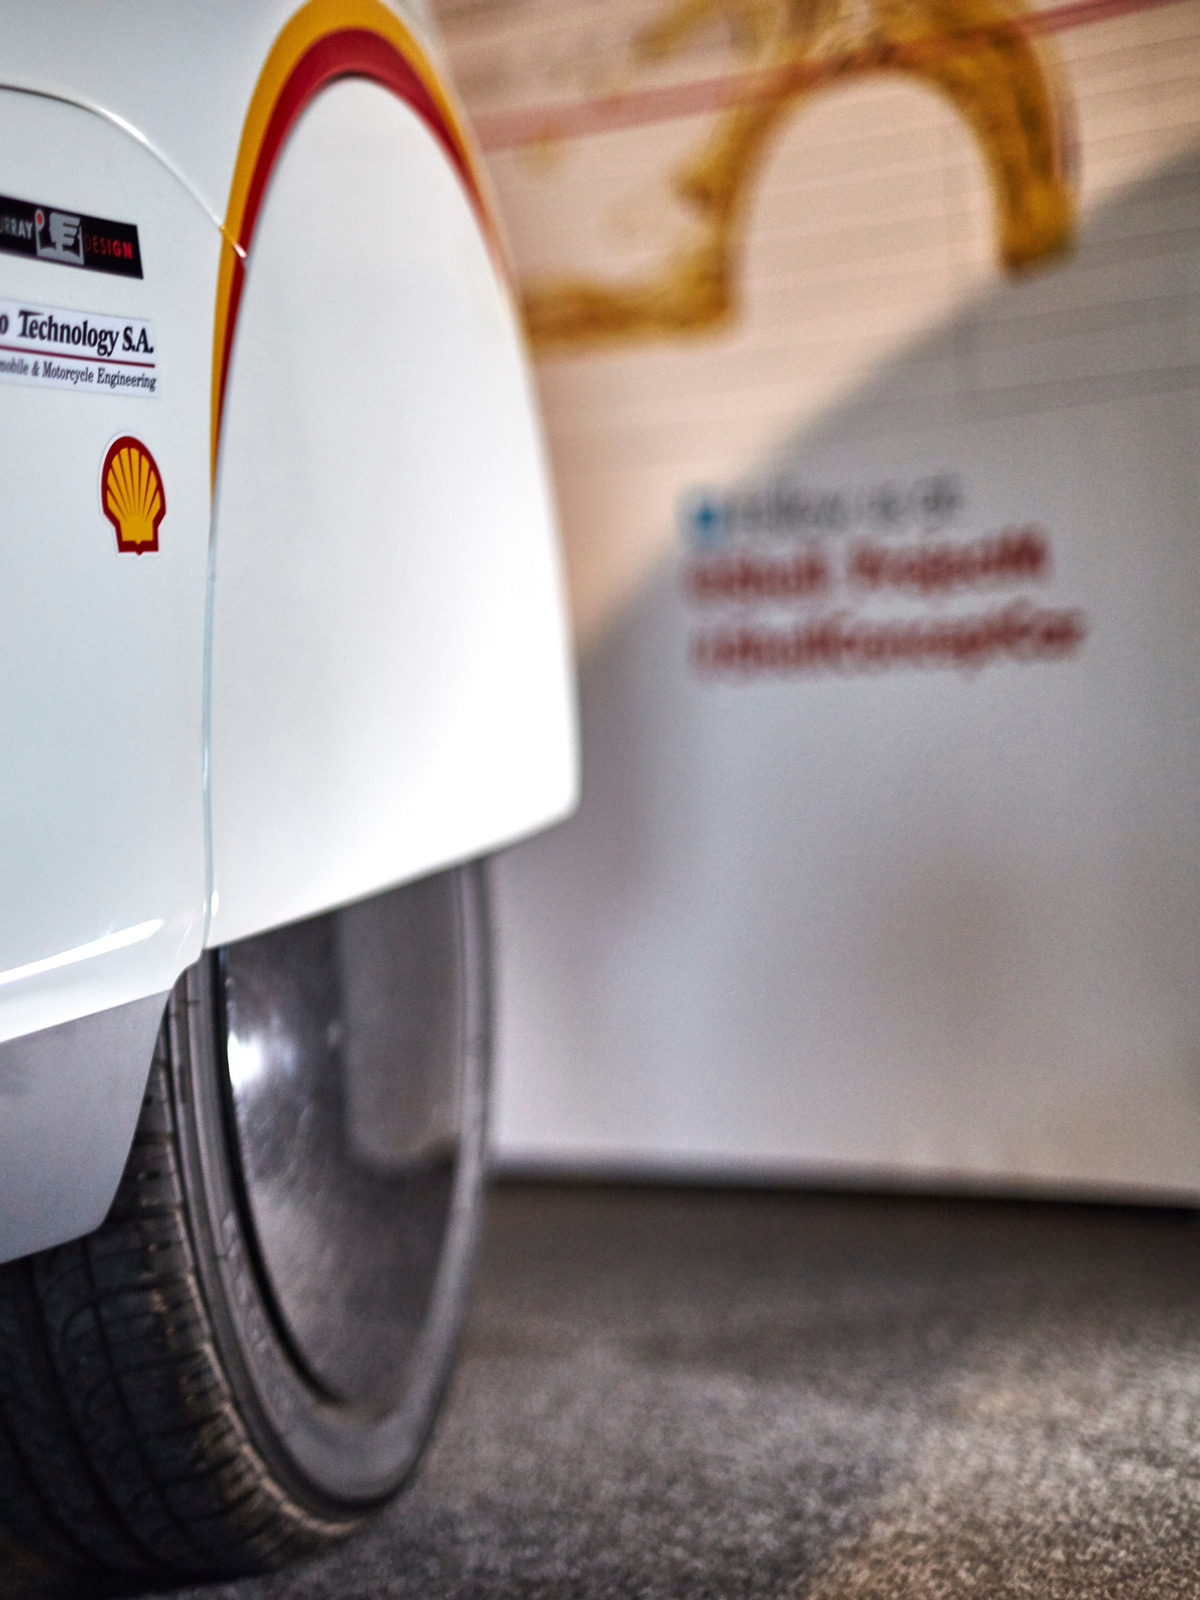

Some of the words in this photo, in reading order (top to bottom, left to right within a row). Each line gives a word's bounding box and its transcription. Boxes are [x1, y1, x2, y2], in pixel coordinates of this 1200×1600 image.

[85, 233, 133, 260] DESIGN
[18, 309, 120, 357] Technology
[122, 325, 154, 354] S.A.
[31, 360, 39, 377] &
[42, 361, 94, 385] Motorcycle
[97, 367, 157, 392] Engineering
